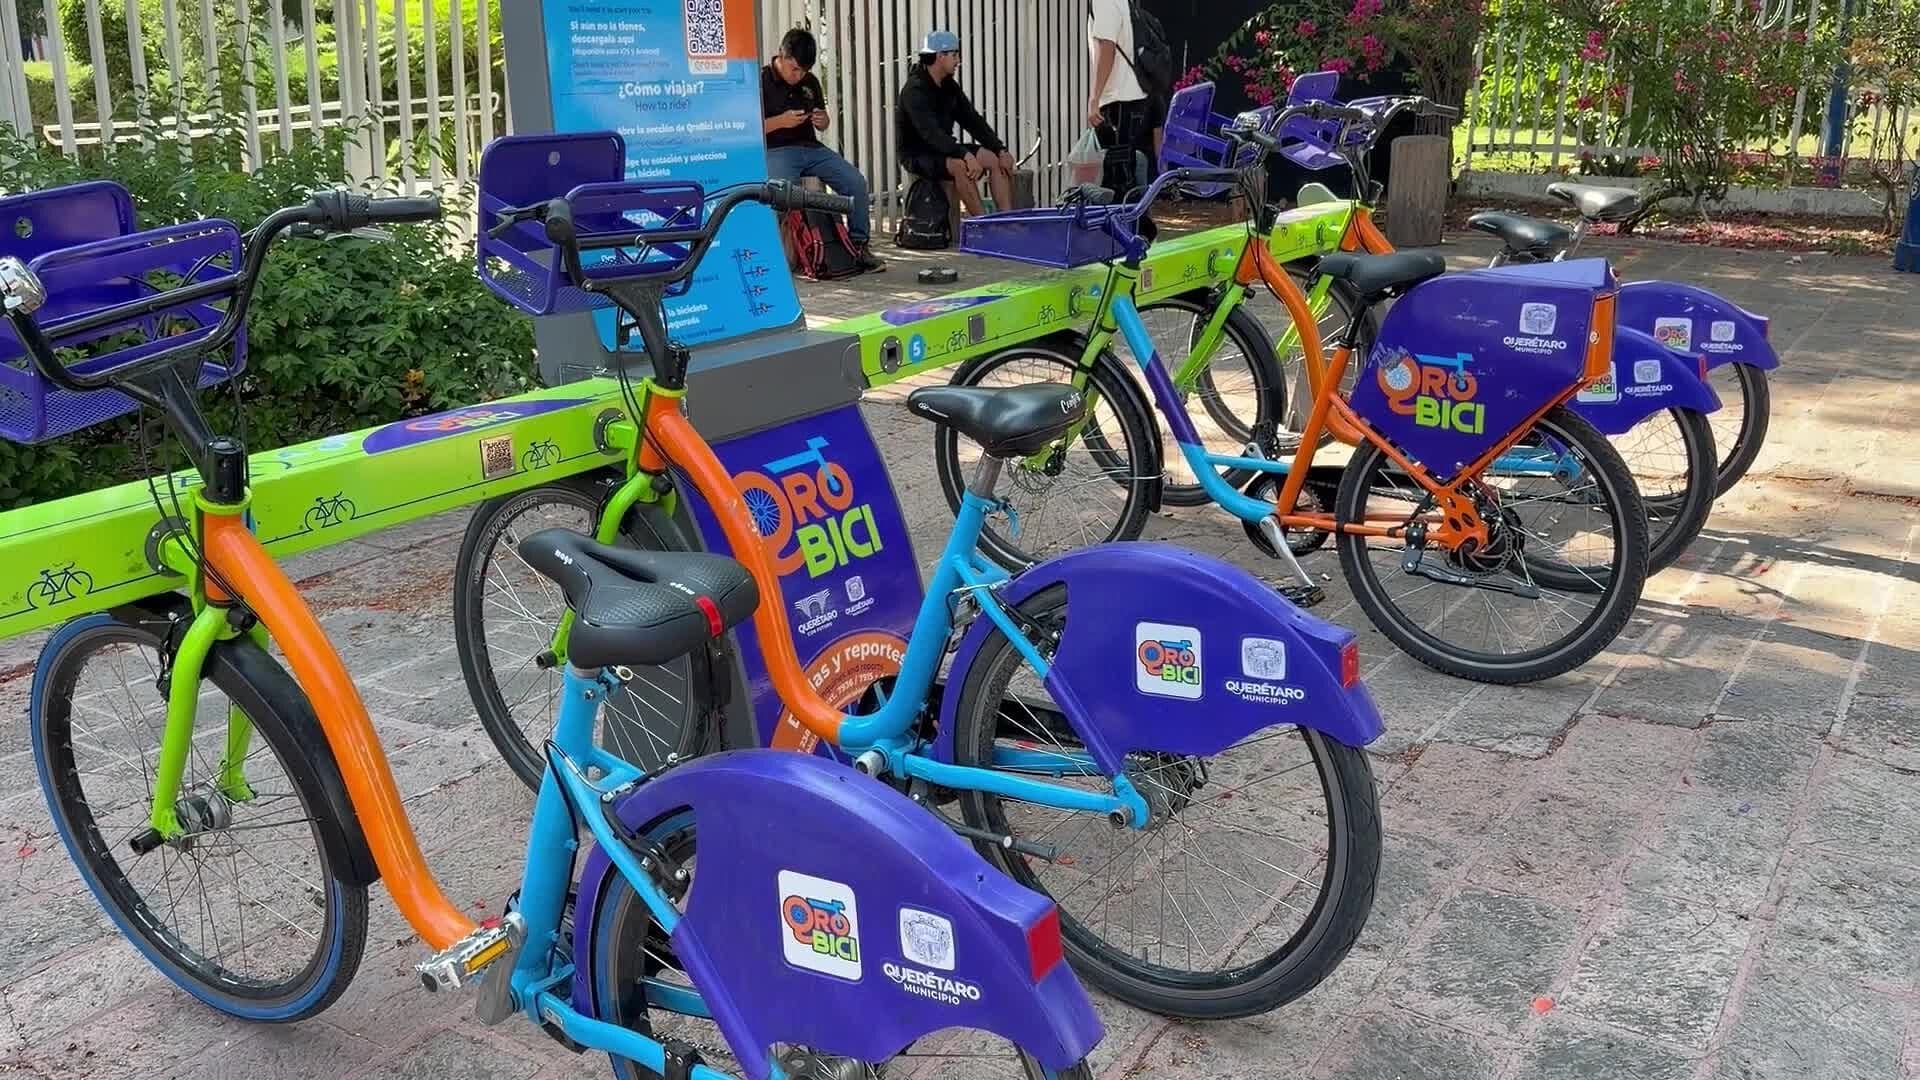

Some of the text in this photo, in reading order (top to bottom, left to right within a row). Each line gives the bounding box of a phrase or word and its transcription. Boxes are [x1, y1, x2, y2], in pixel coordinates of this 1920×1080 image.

[618, 80, 705, 98] ¿Cómo viajar?
[912, 341, 921, 356] 5
[1503, 335, 1567, 352] QUERÉTARO
[1376, 356, 1478, 416] QRO
[1415, 395, 1485, 435] BICI
[731, 462, 854, 577] QRO
[796, 503, 884, 578] BICI
[798, 609, 838, 635] QUERÉTARO
[831, 652, 841, 673] y
[1138, 640, 1196, 676] QRO
[1161, 663, 1200, 685] BICI
[1225, 680, 1305, 700] QUERÉTARO
[1242, 693, 1288, 705] MUNICIPIO
[783, 895, 850, 944] QRO
[812, 929, 859, 962] BICI
[882, 962, 981, 1001] QUERÉTARO
[903, 983, 960, 1005] MUNICIPIO
